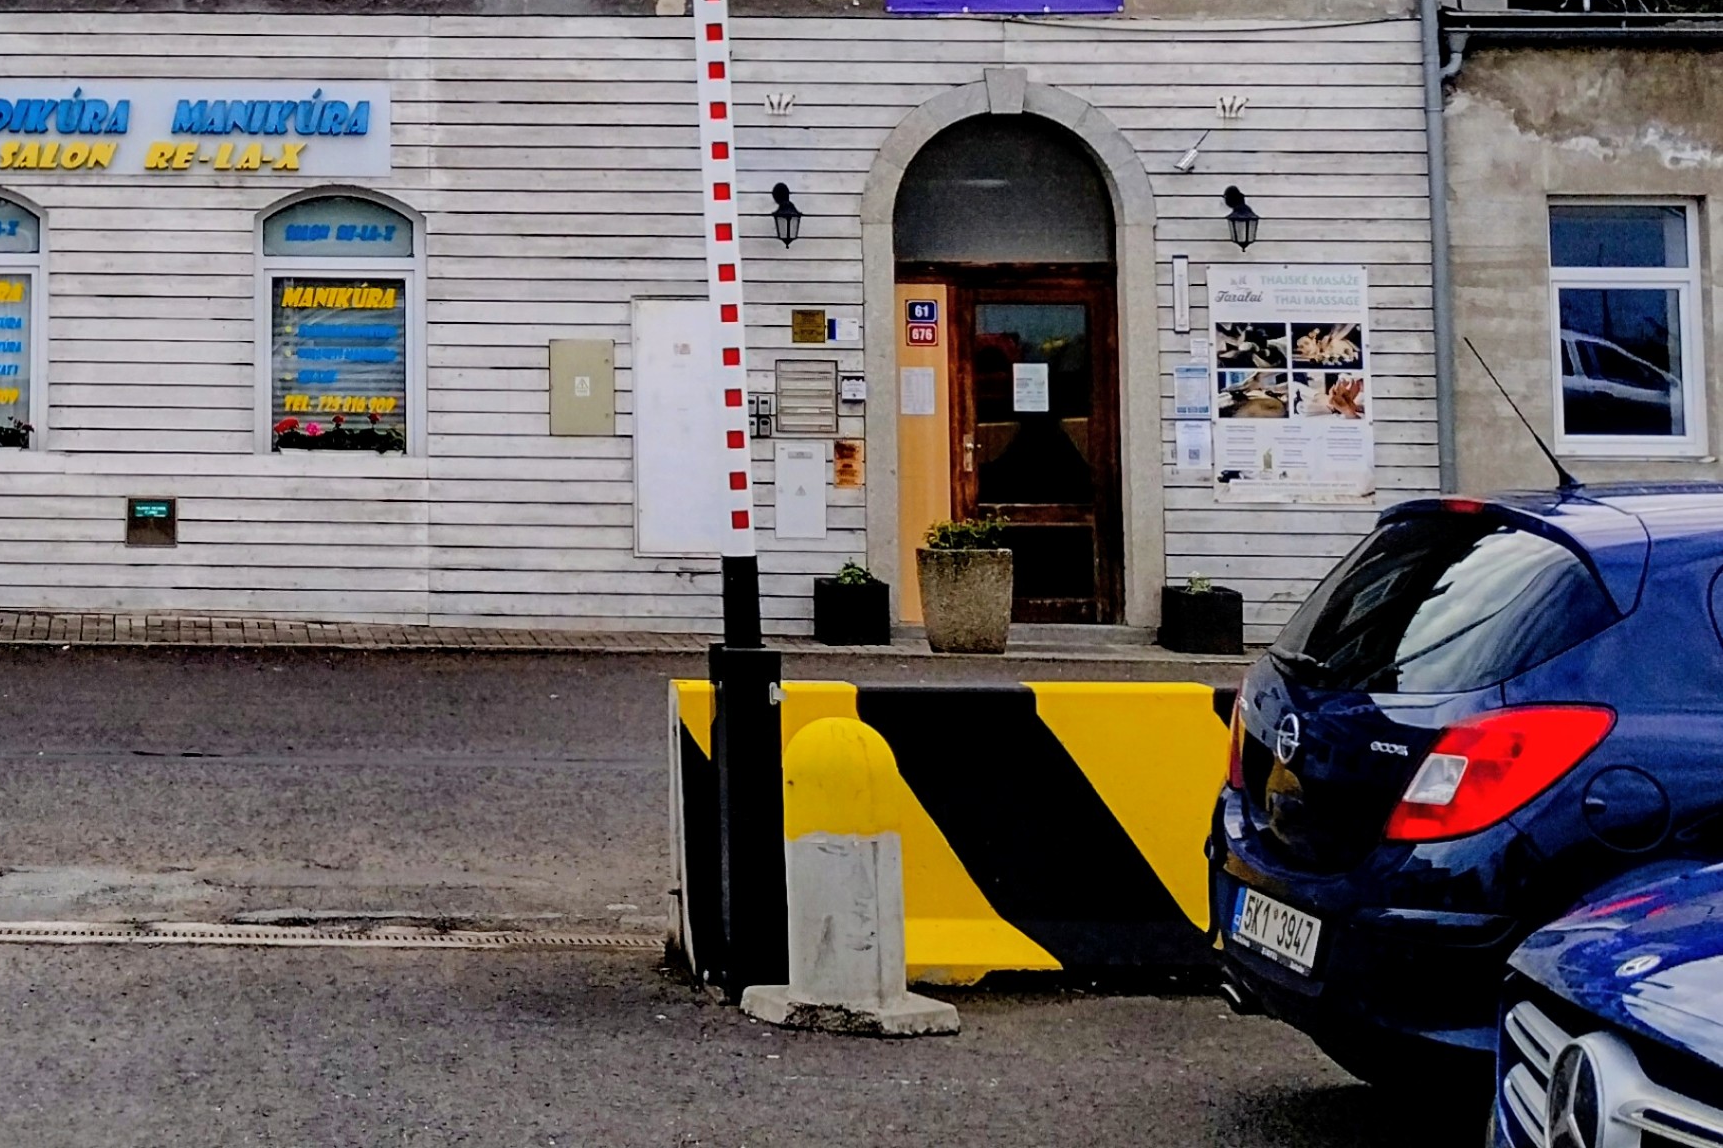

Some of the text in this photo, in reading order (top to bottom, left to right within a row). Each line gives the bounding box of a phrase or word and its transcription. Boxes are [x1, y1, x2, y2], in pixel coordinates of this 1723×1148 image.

[171, 88, 371, 136] MANIKÚRA
[144, 141, 307, 171] RE-LA-X
[281, 282, 397, 309] MANIKÚRA
[1274, 295, 1361, 306] THAI MASSAGE
[915, 305, 929, 318] 61
[912, 328, 933, 340] 676
[1277, 910, 1314, 957] 3947
